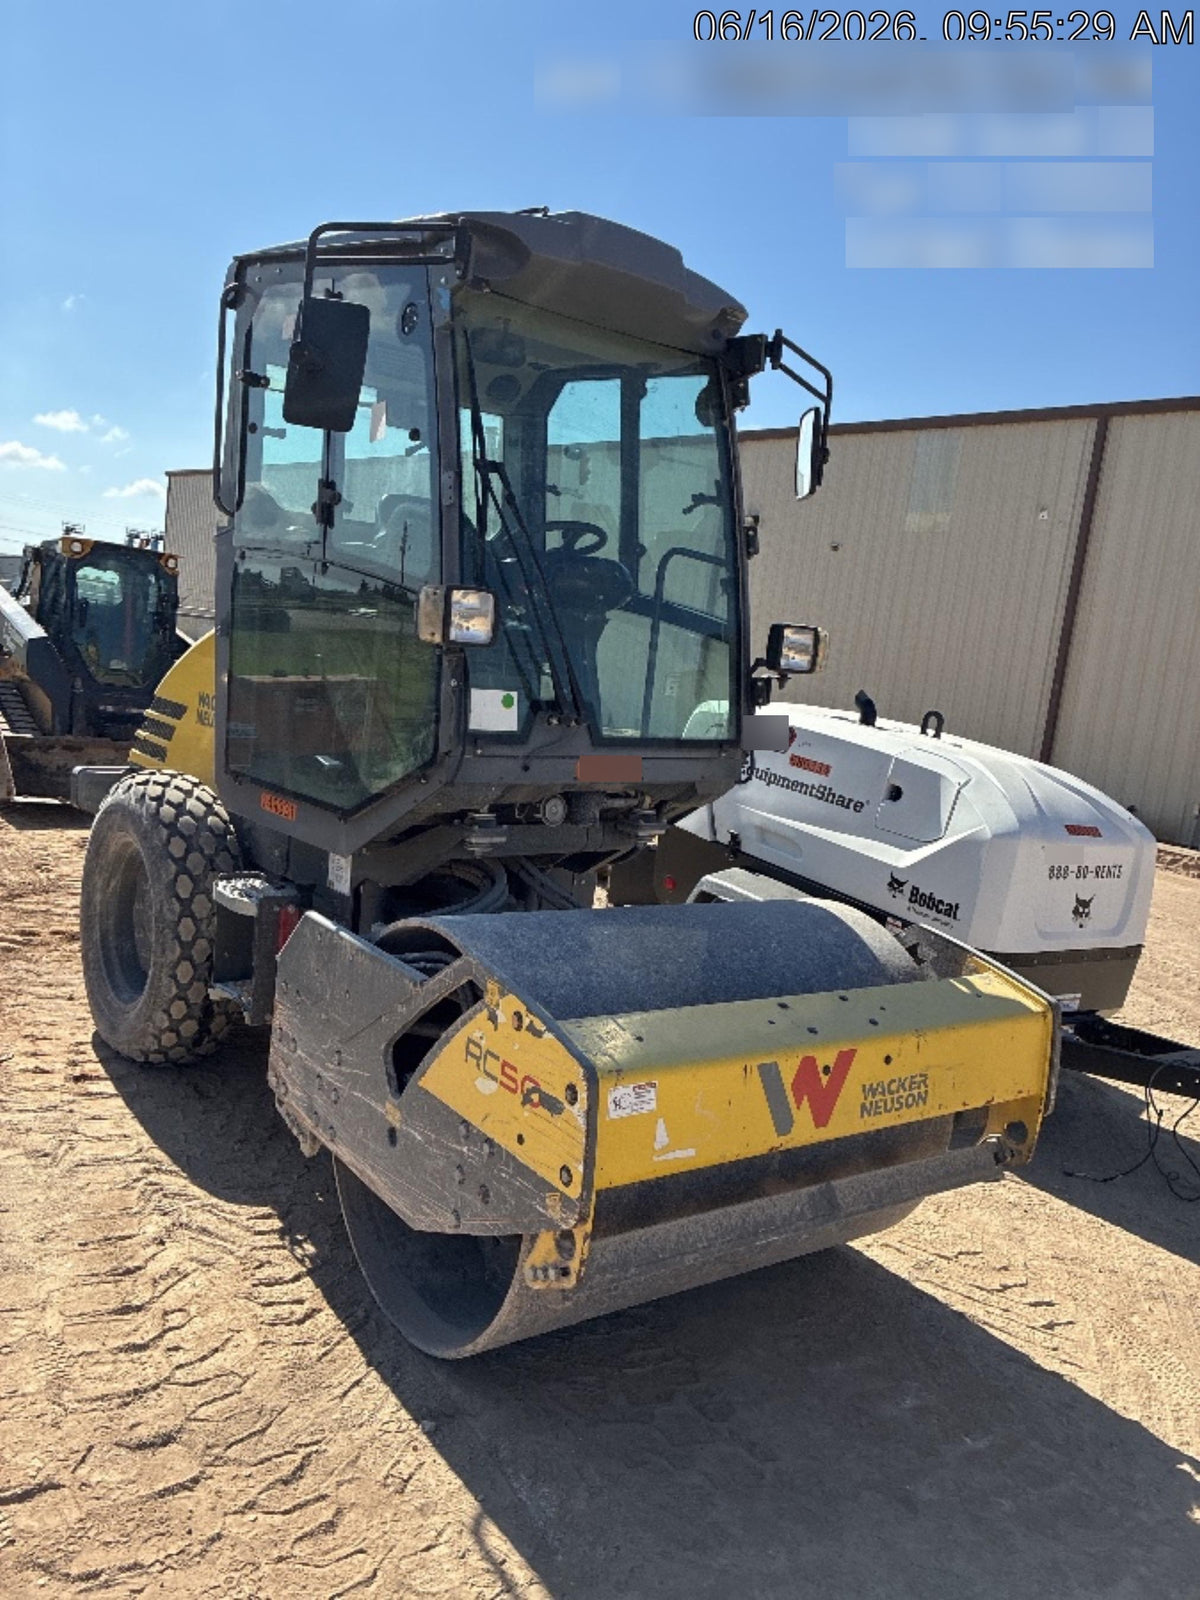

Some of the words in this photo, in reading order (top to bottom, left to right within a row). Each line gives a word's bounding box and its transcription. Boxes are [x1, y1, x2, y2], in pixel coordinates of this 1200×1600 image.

[908, 885, 960, 920] Bobcat
[861, 1073, 929, 1101] WACKER
[860, 1090, 929, 1119] NEUSON
